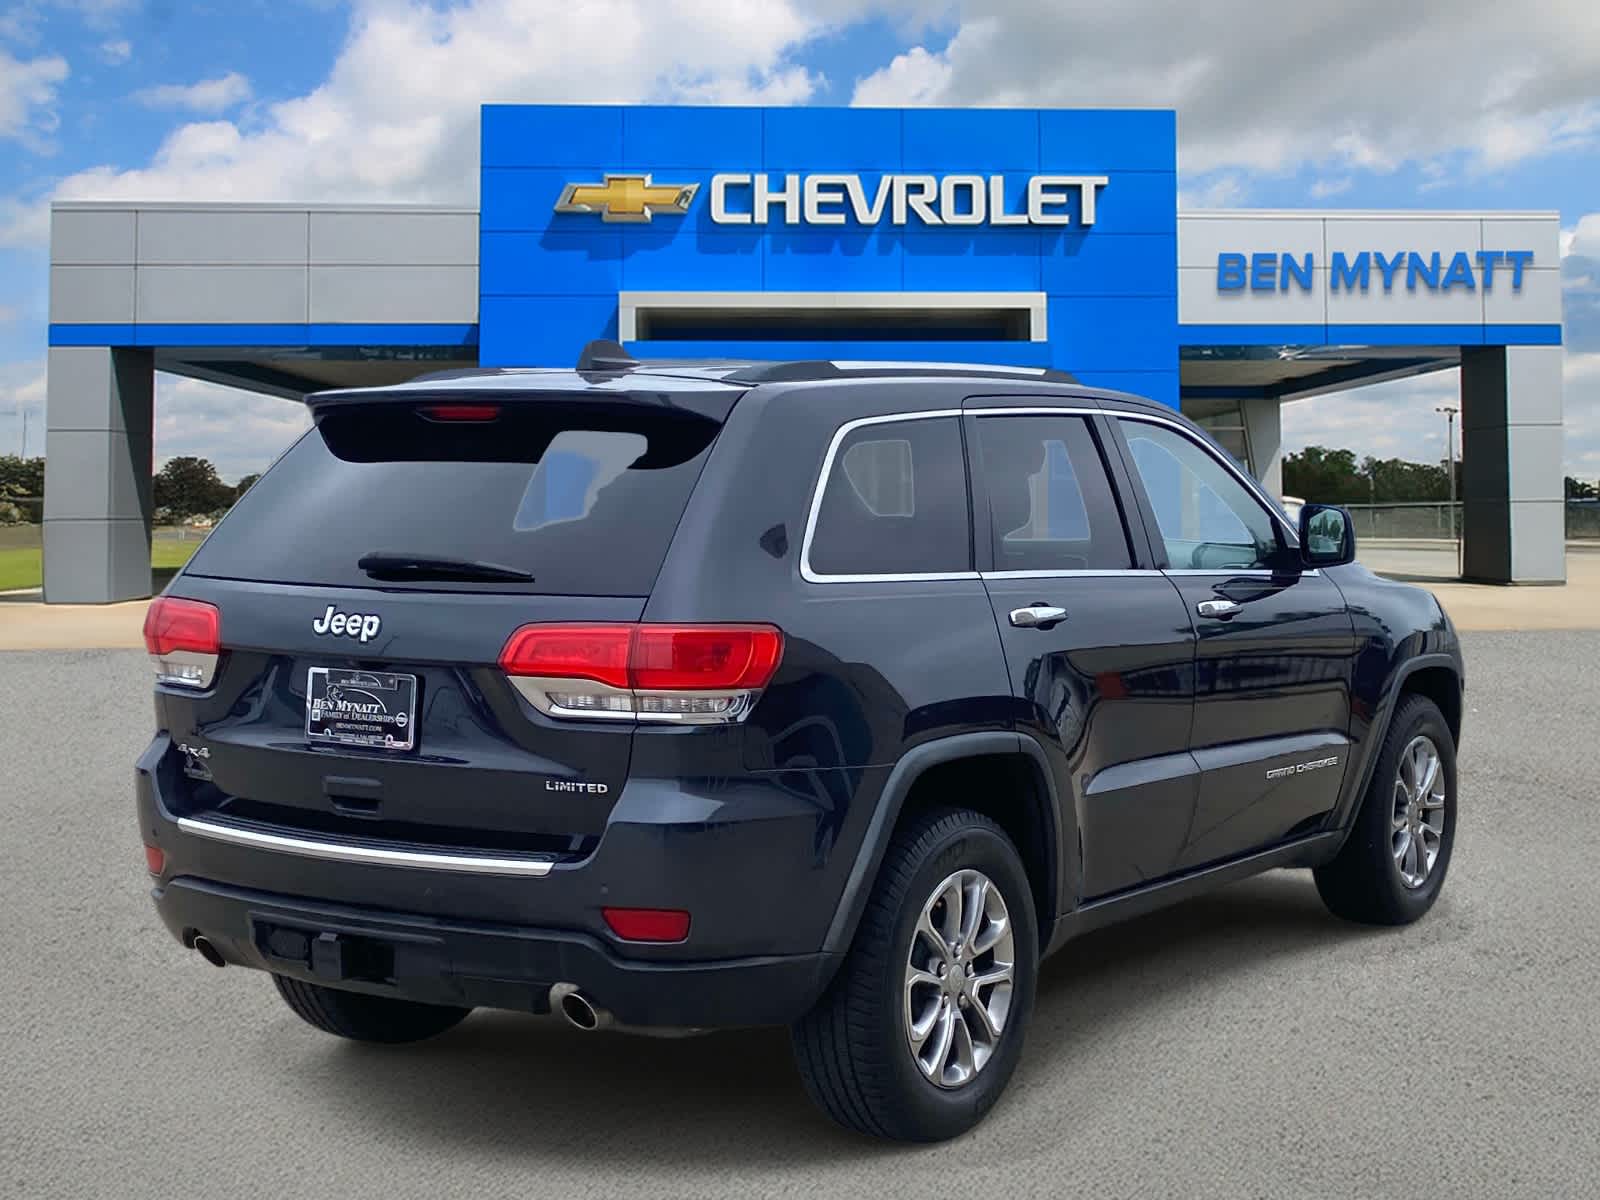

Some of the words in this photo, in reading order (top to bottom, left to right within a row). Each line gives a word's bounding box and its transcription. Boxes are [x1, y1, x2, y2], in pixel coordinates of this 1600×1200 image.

[711, 173, 1109, 226] CHEVROLET
[1217, 252, 1314, 291] BEN
[1330, 250, 1534, 291] MYNATT
[313, 605, 380, 642] Jeep
[312, 698, 335, 711] BEN
[336, 700, 381, 714] MYNATT
